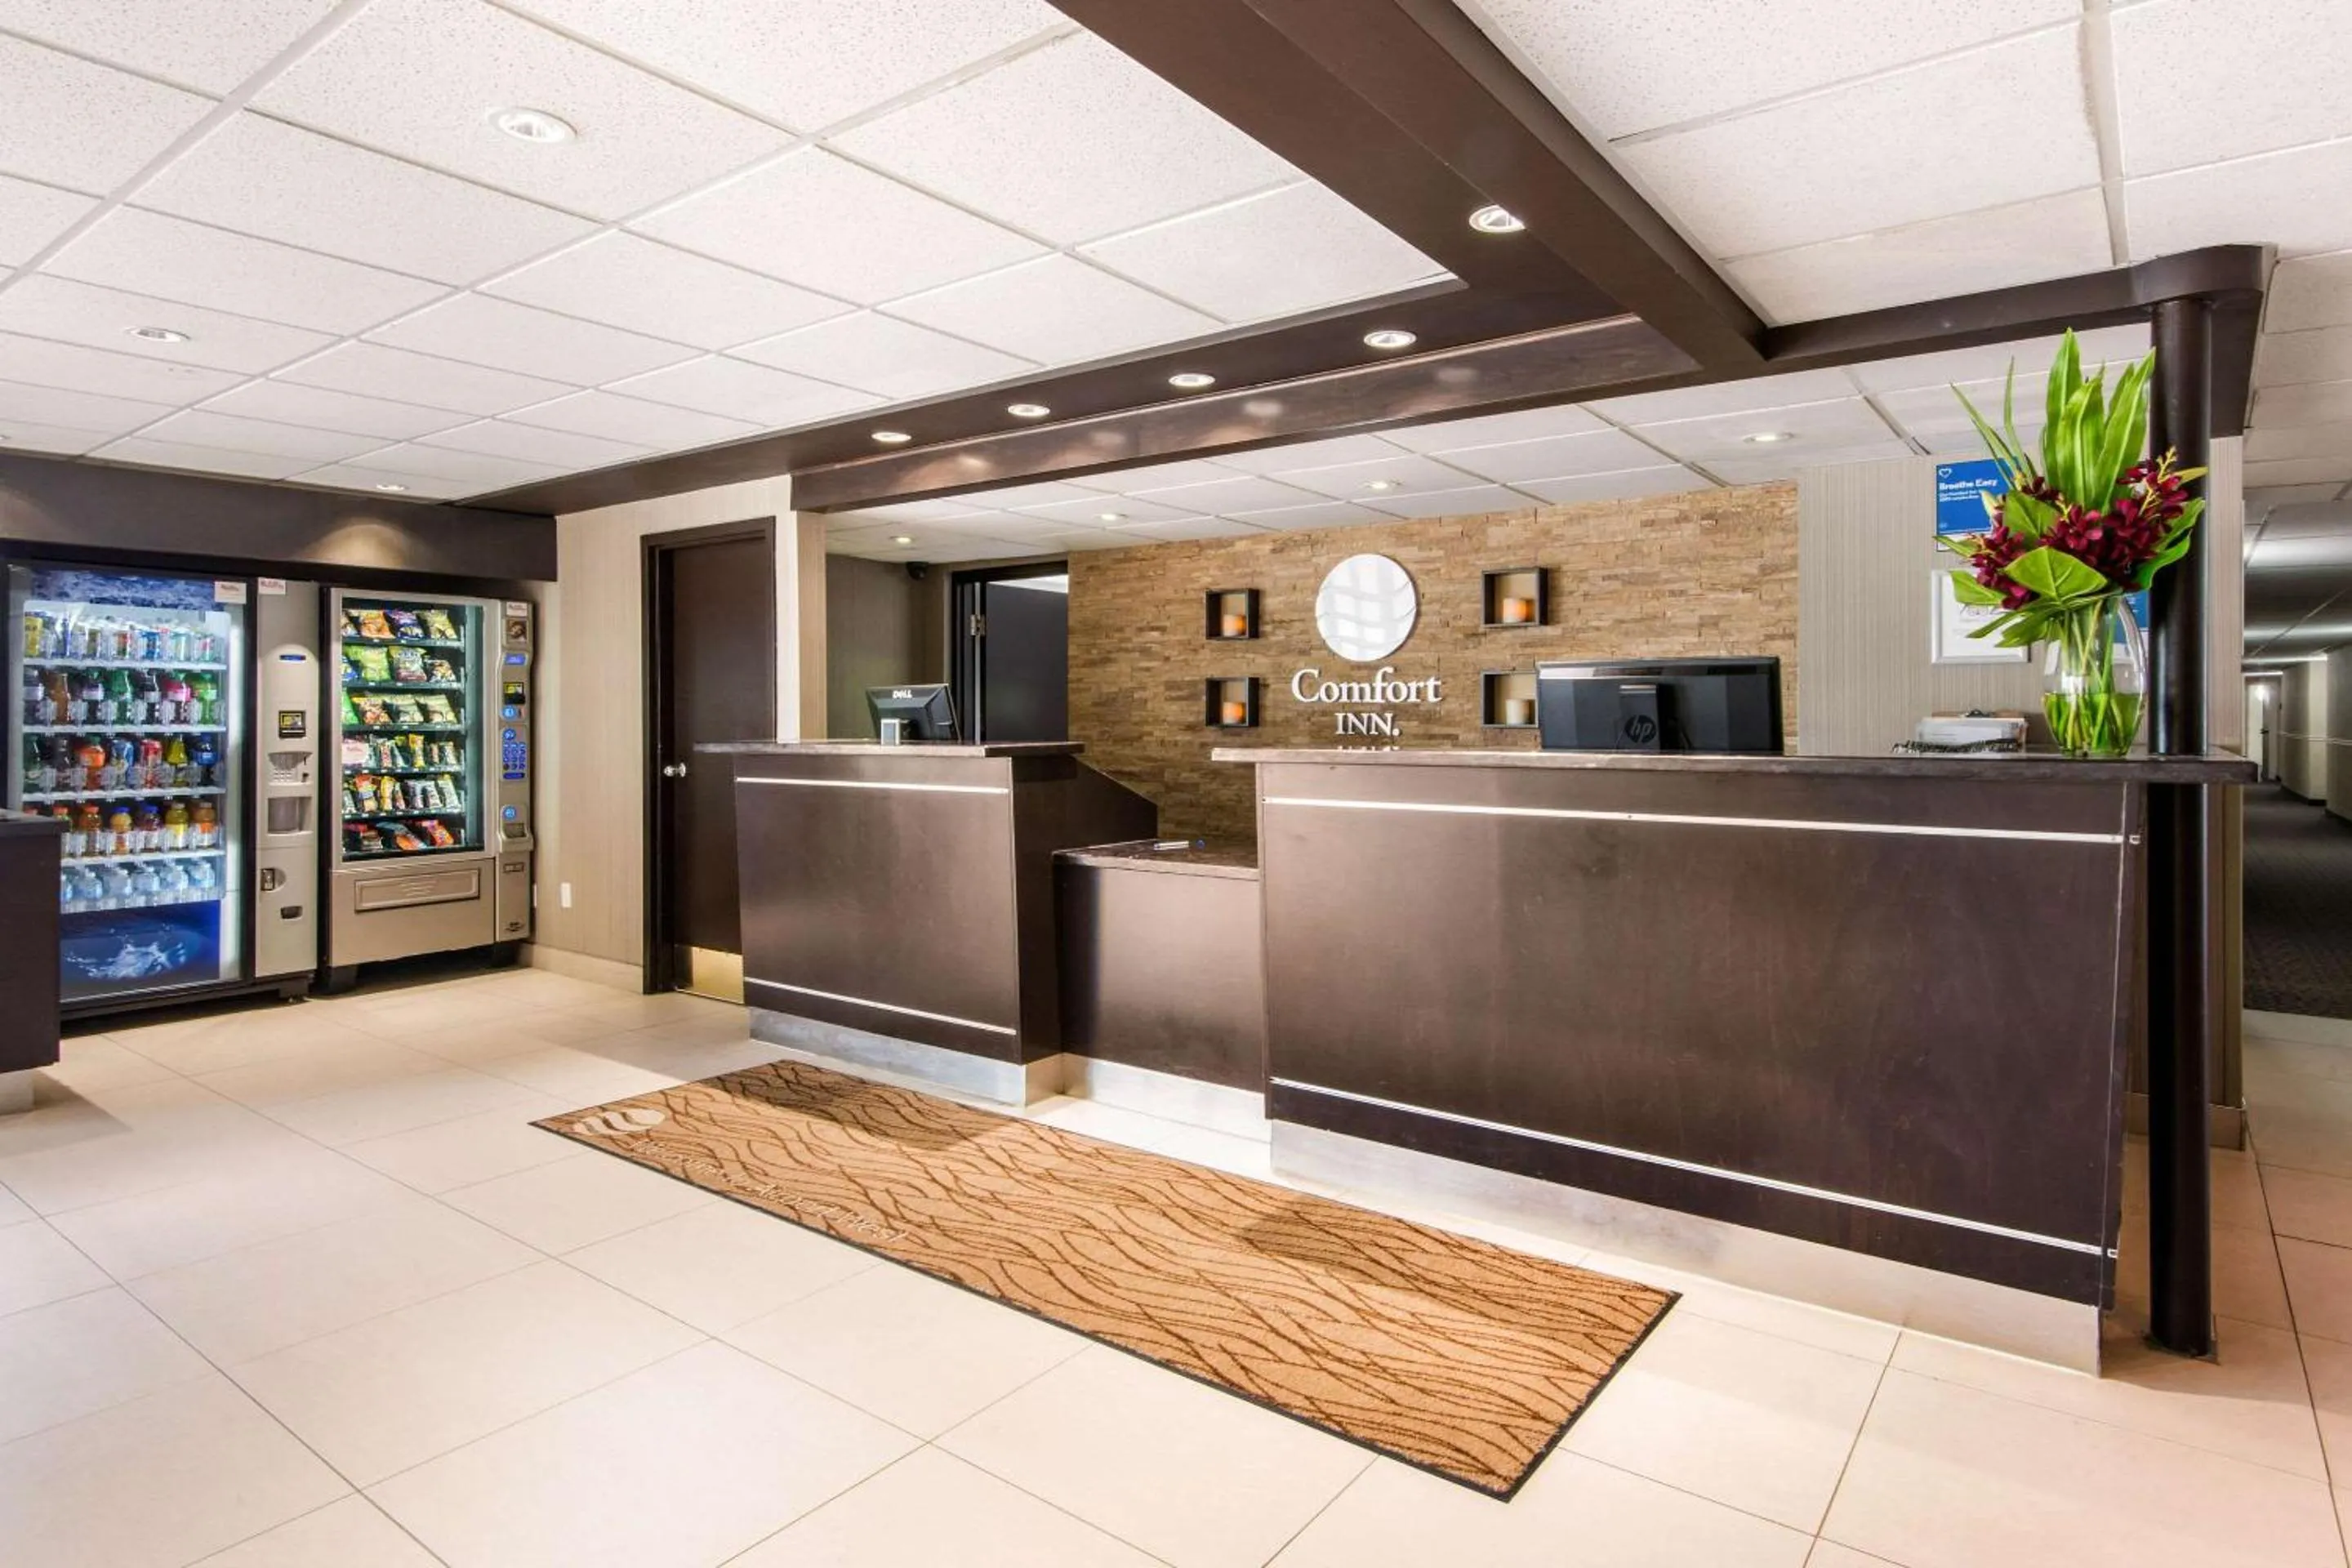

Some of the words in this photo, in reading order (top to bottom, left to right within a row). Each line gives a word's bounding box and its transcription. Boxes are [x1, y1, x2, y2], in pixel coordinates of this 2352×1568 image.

[892, 689, 913, 699] DELL
[1291, 666, 1442, 703] Comfort
[1629, 714, 1654, 744] hp
